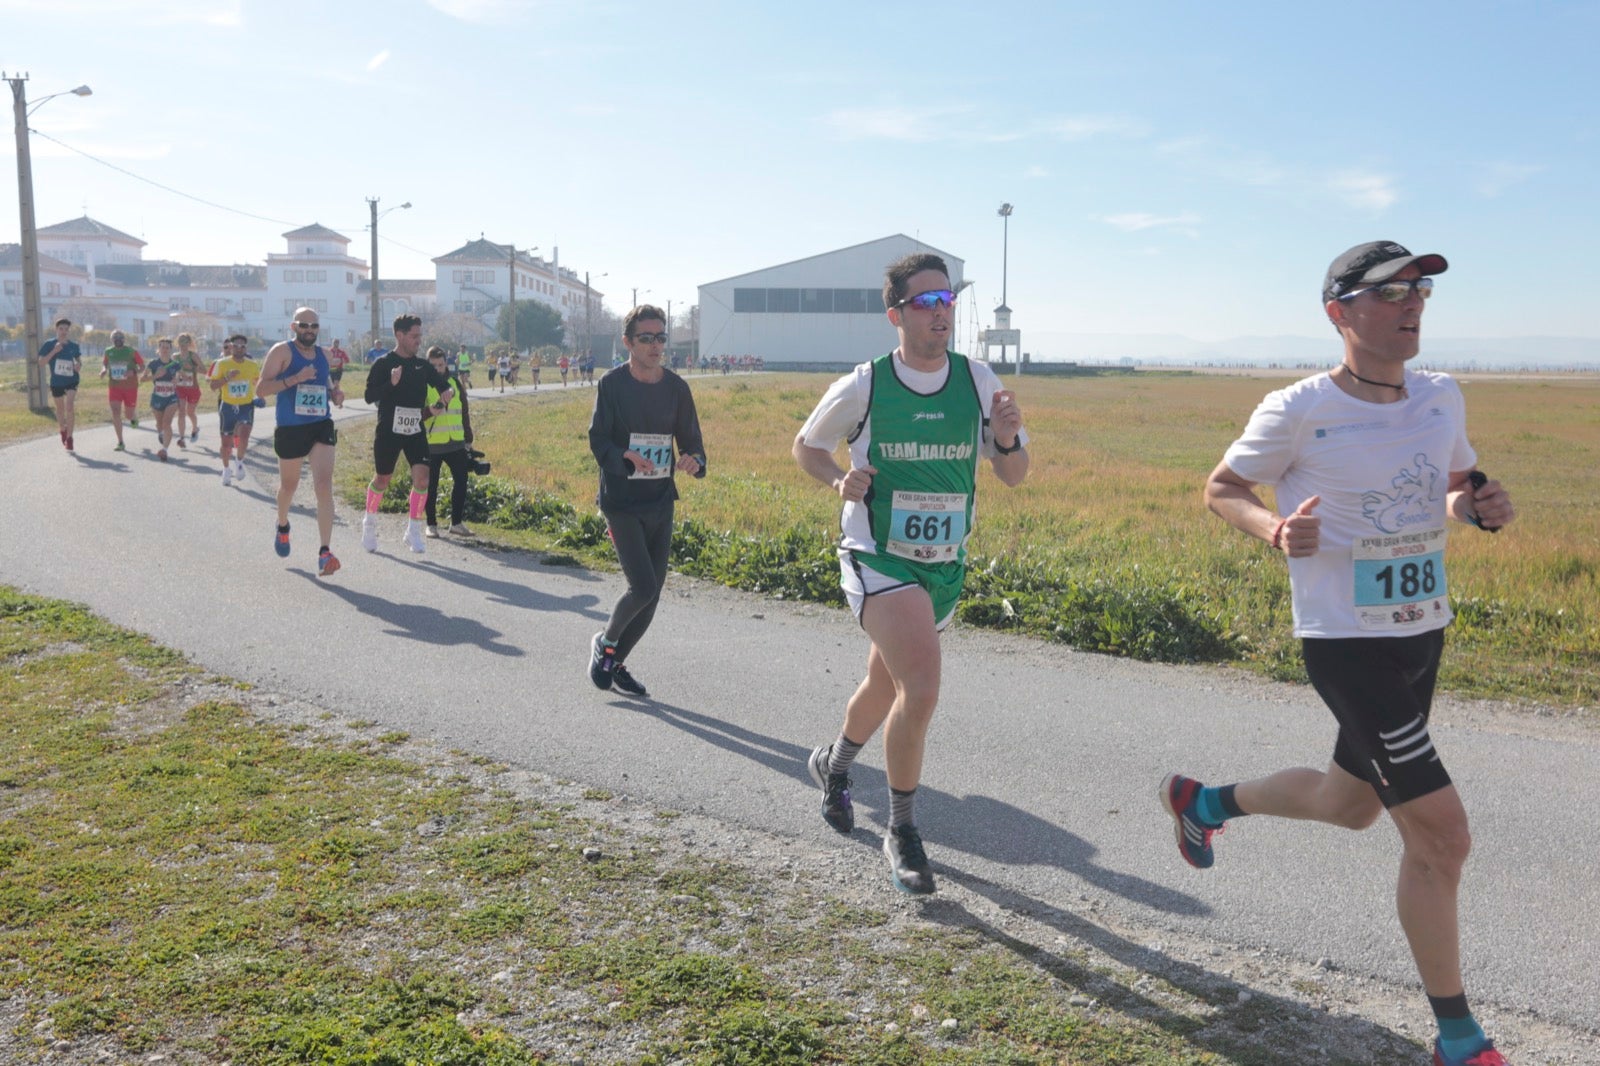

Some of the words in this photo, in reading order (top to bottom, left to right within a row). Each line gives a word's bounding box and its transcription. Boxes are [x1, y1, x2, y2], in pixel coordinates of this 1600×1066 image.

[230, 384, 248, 394] 517
[302, 394, 323, 406] 224
[397, 416, 420, 426] 3087
[636, 448, 672, 465] 117
[879, 442, 917, 458] TEAM
[920, 442, 974, 460] HALCÓN
[904, 515, 952, 541] 661
[1376, 560, 1436, 599] 188
